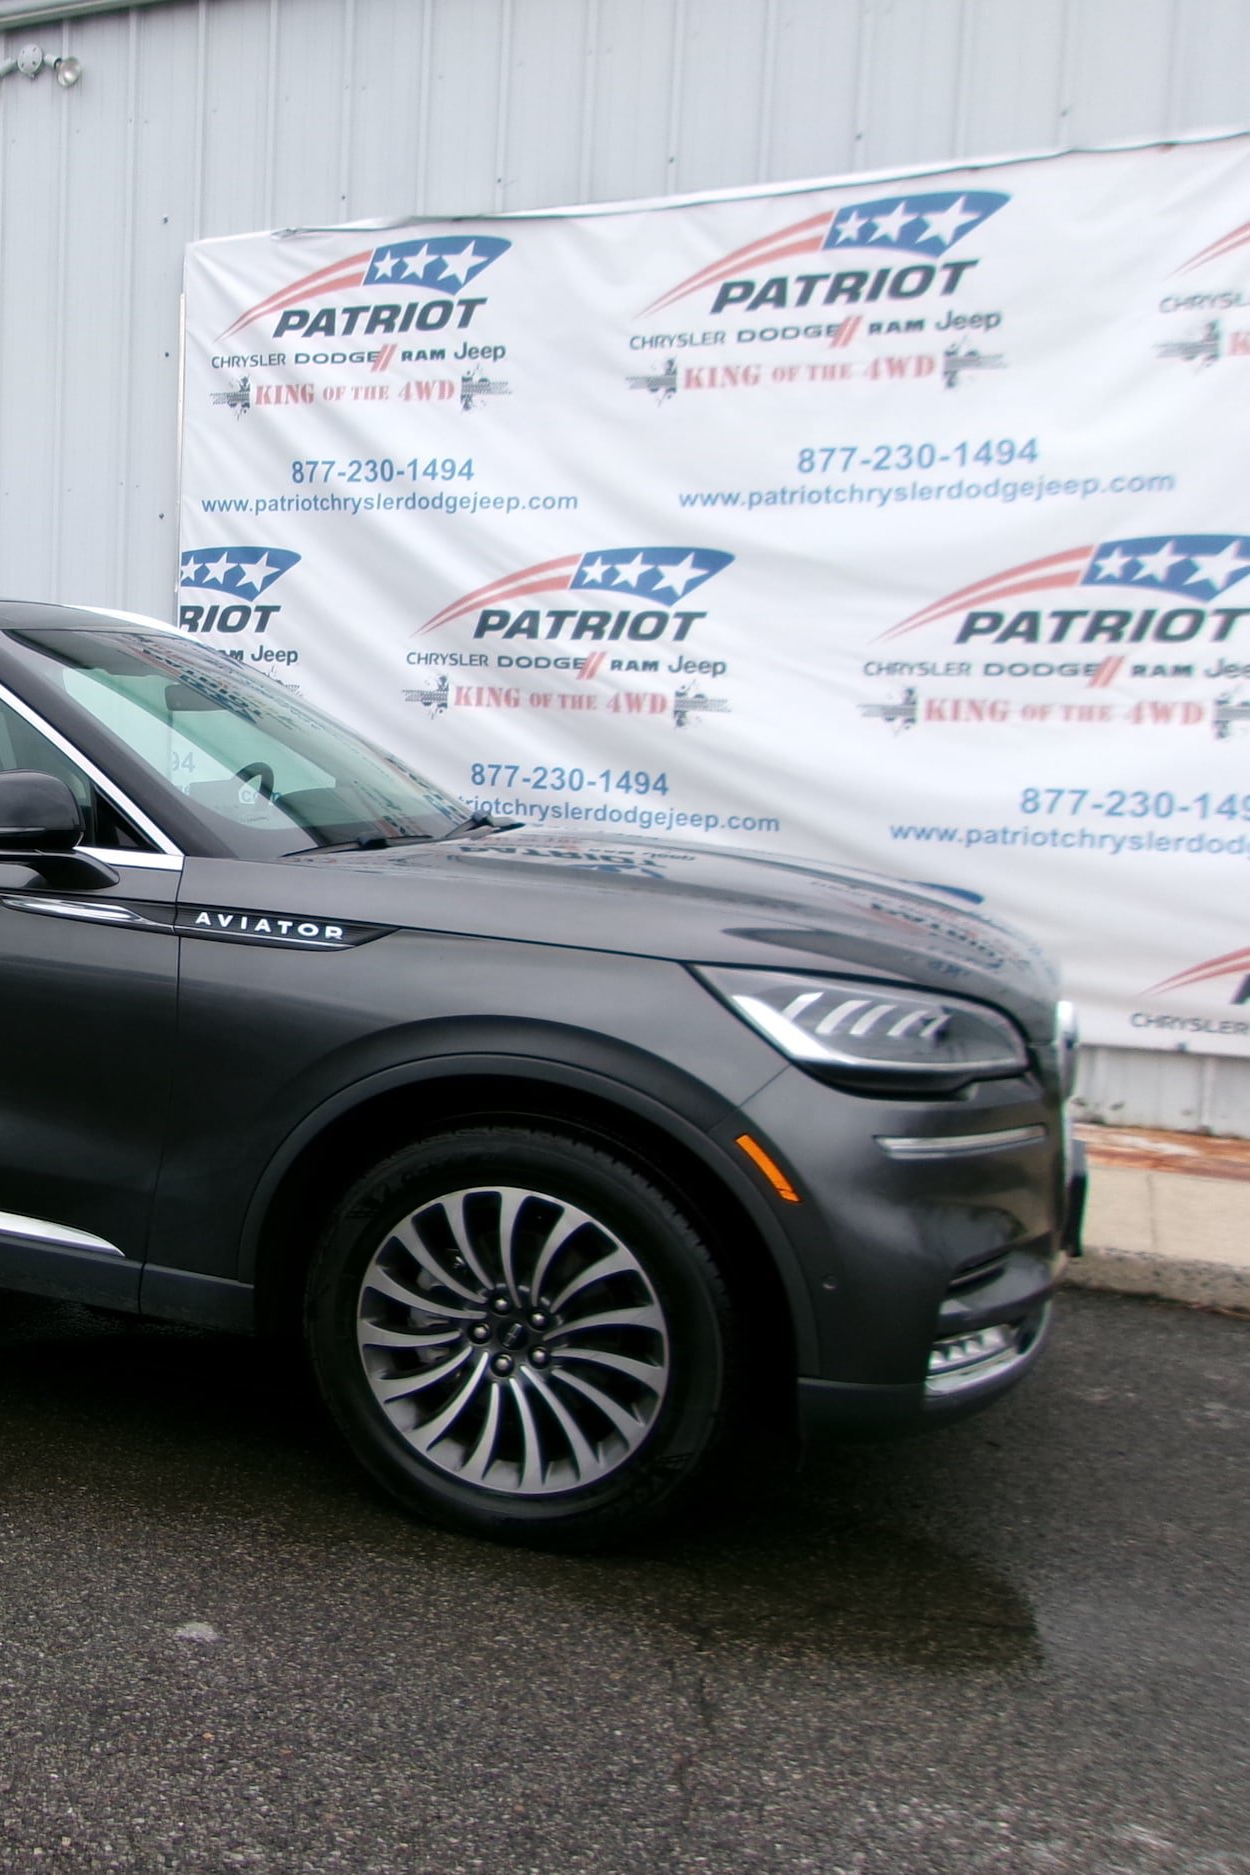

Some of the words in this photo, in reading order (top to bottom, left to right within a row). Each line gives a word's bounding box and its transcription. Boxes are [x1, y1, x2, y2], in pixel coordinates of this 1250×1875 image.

[710, 257, 979, 315] PATRIOT
[272, 297, 488, 338] PATRIOT
[628, 330, 727, 351] CHRYSLER
[736, 322, 840, 345] DODGE
[868, 318, 927, 335] RAM
[934, 309, 1003, 332] Jeep
[211, 352, 287, 370] CHRYSLER
[294, 351, 379, 365] DODGE
[401, 348, 446, 362] RAM
[453, 341, 507, 363] Jeep
[683, 365, 761, 390] KING
[771, 364, 799, 383] OF
[807, 361, 853, 382] THE
[865, 353, 937, 382] 4WD
[255, 383, 315, 406] KING
[322, 386, 344, 402] OF
[353, 385, 389, 401] THE
[398, 379, 456, 402] 4WD
[291, 458, 475, 484] 877-230-1494
[797, 437, 1040, 475] 877-230-1494
[201, 492, 578, 516] www.patriotchryslerdodgejeep.com
[678, 471, 1177, 511] www.patriotchryslerdodgejeep.com
[472, 609, 707, 642] PATRIOT
[250, 644, 299, 667] Jeep
[406, 651, 489, 668] CHRYSLER
[497, 654, 586, 670] DODGE
[610, 659, 660, 673] RAM
[667, 654, 728, 679] Jeep
[862, 660, 973, 677] CHRYSLER
[982, 661, 1098, 678] DODGE
[1131, 663, 1195, 678] RAM
[452, 684, 521, 709] KING
[528, 692, 553, 709] OF
[557, 693, 597, 711] THE
[606, 691, 668, 715] 4WD
[924, 698, 1008, 722] KING
[1019, 703, 1053, 722] OF
[1060, 704, 1112, 723] THE
[1126, 700, 1205, 726] 4WD
[470, 762, 670, 796] 877-230-1494
[195, 911, 344, 941] AVIATOR
